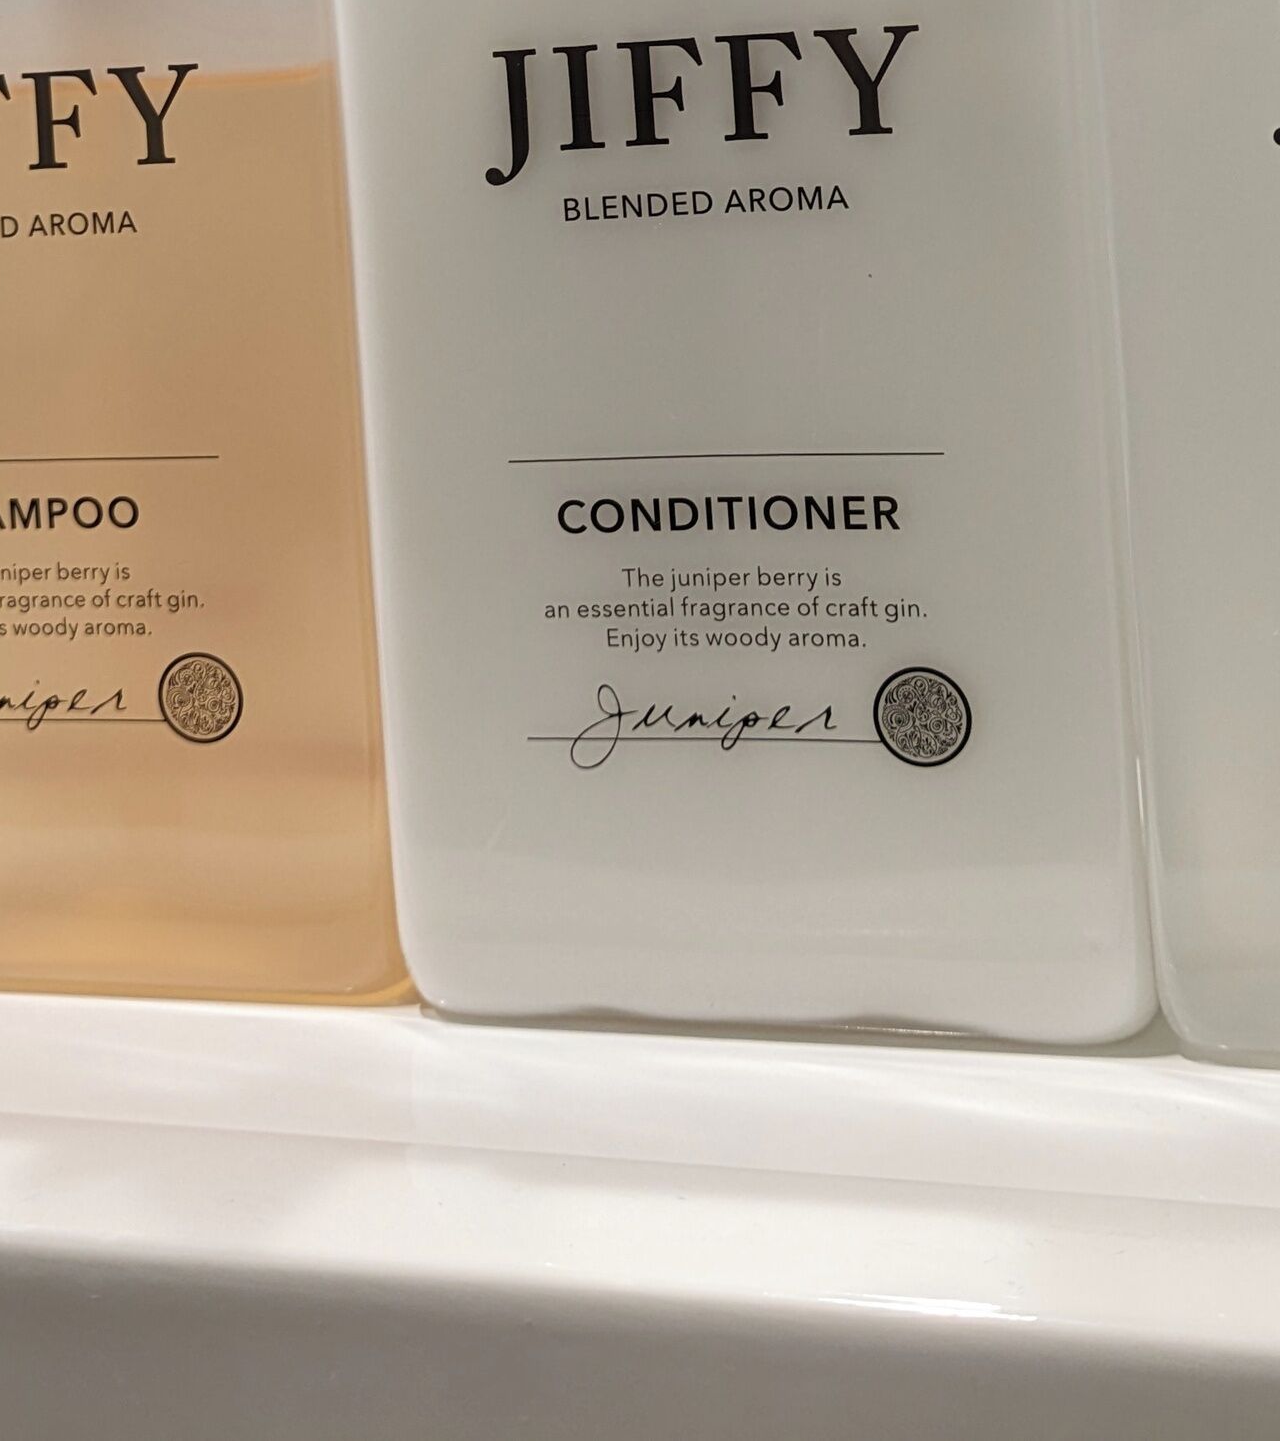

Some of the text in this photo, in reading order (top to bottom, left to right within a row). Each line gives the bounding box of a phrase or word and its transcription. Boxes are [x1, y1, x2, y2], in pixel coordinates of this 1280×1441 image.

[485, 25, 919, 190] JIFFY
[564, 185, 849, 221] BLENDED AROMA
[29, 211, 137, 237] AROMA
[558, 495, 900, 534] CONDITIONER
[56, 561, 110, 586] berry
[115, 562, 130, 581] is
[622, 566, 841, 592] The juniper berry is
[91, 588, 111, 608] of
[116, 588, 162, 608] craft
[167, 590, 204, 614] gin.
[545, 596, 926, 623] an essential fragrance of craft gin.
[13, 617, 78, 641] woody
[84, 623, 152, 636] aroma.
[607, 626, 866, 653] Enjoy its woody aroma.
[569, 683, 838, 770] Juniper
